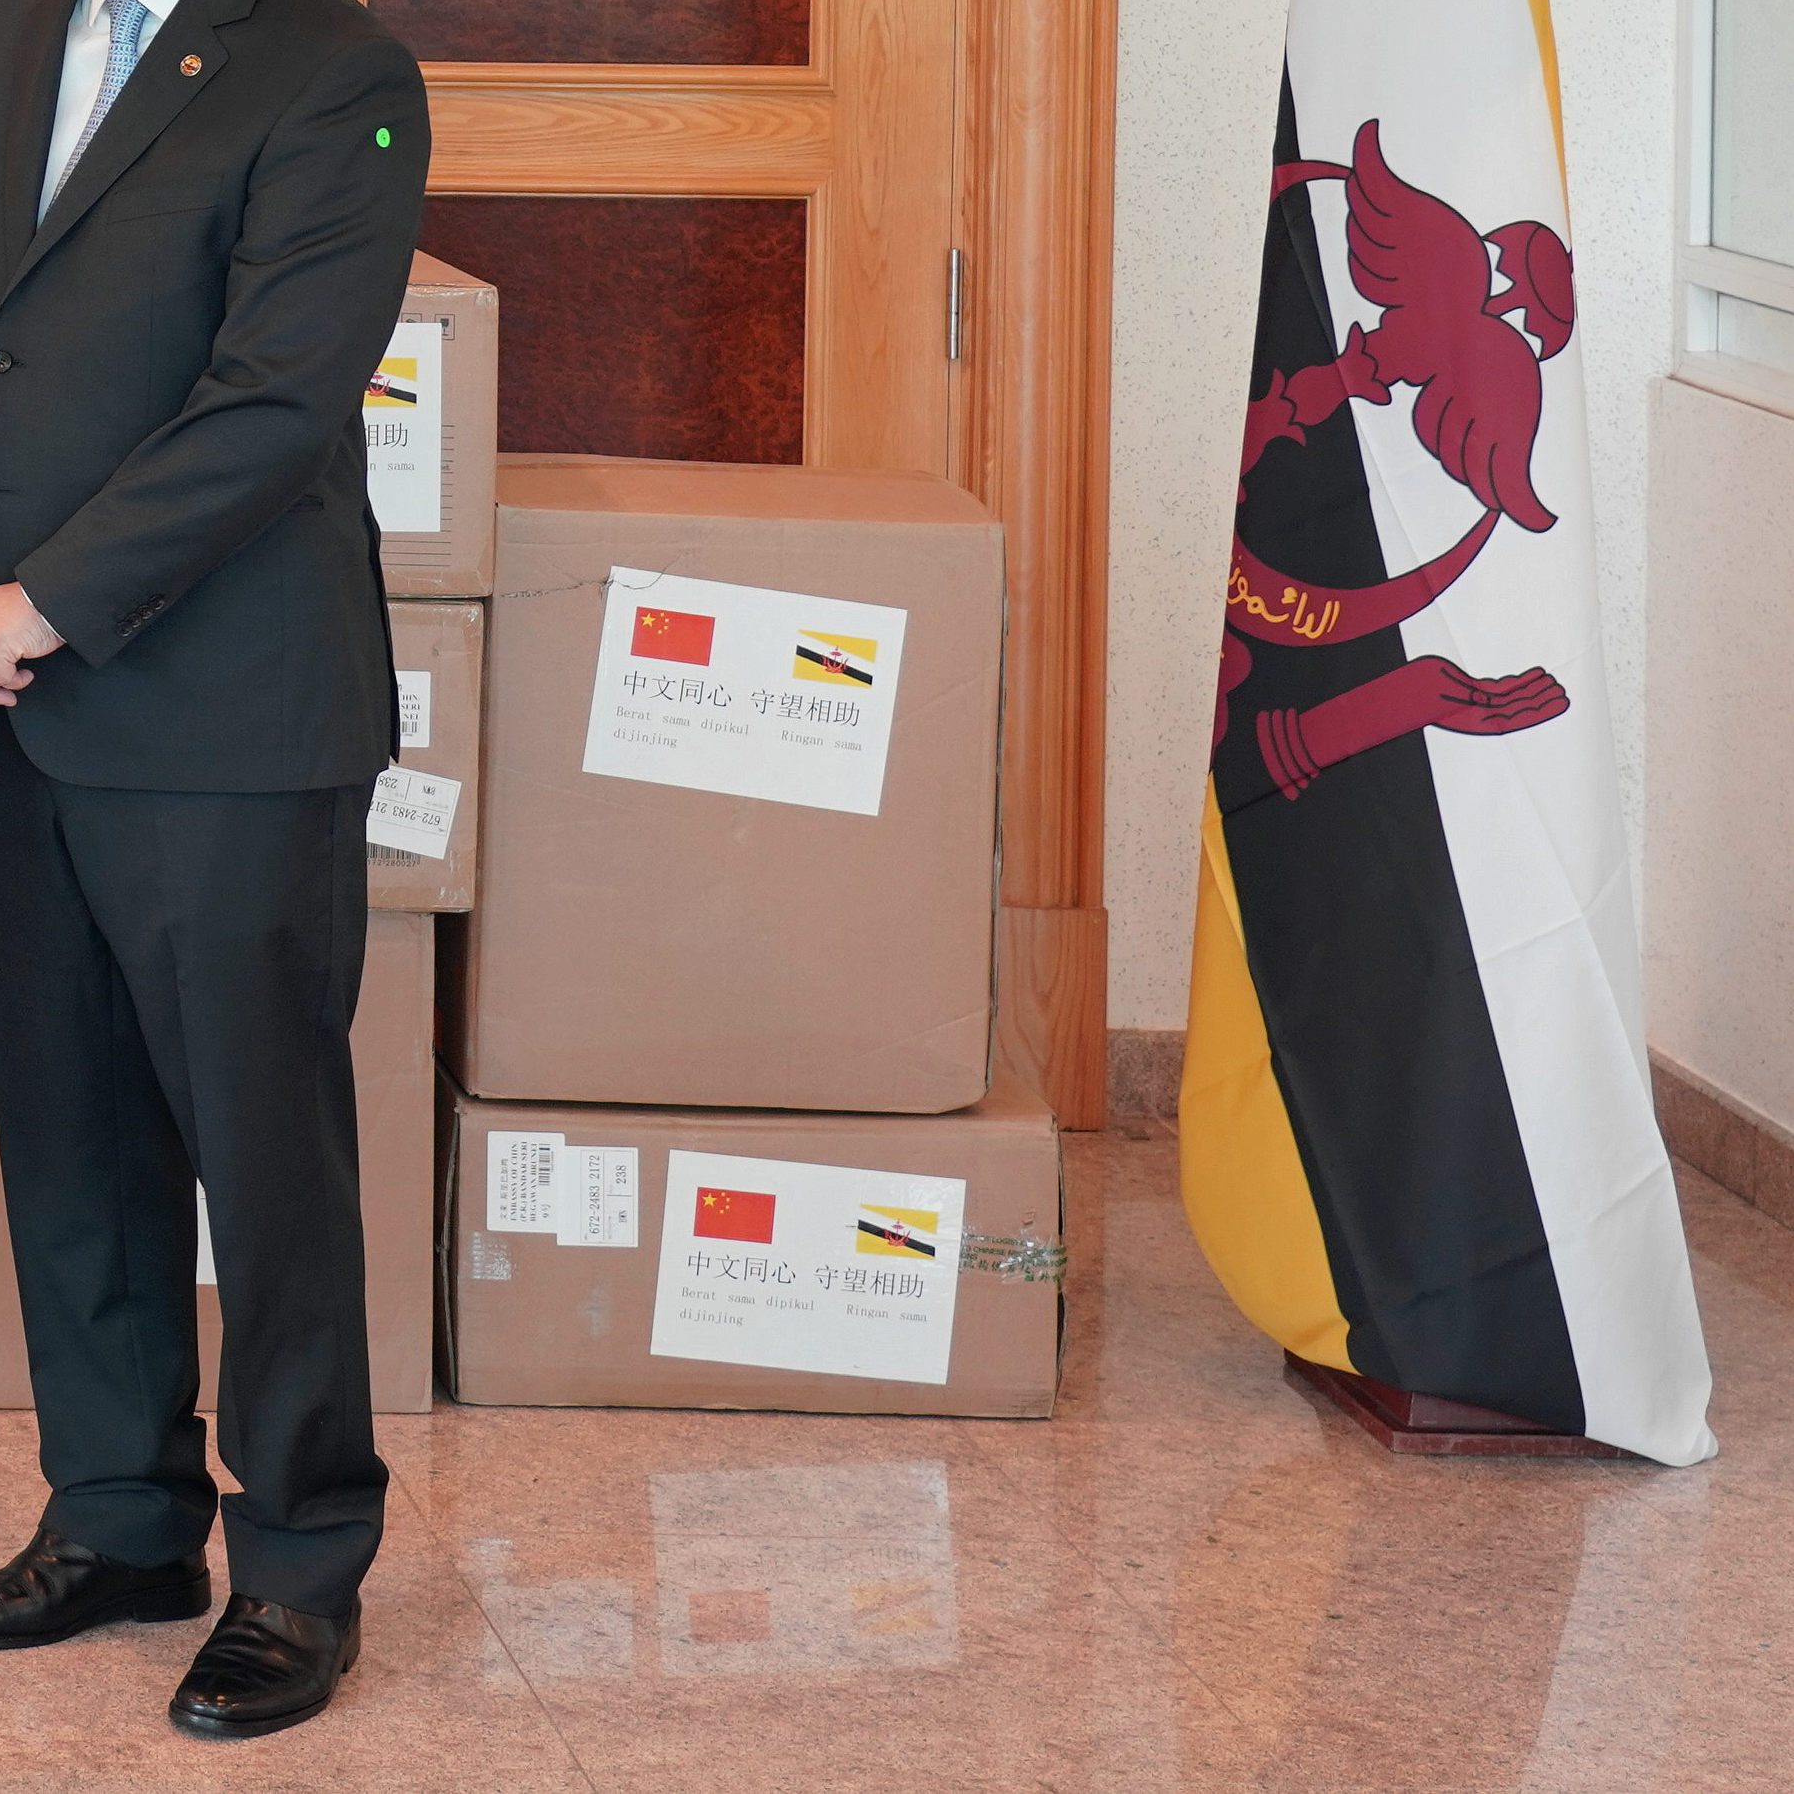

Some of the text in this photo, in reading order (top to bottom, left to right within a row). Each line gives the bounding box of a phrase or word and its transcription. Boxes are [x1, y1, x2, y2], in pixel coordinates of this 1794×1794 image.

[387, 463, 415, 471] sama
[624, 671, 860, 727] 中文同心 守望相助
[612, 726, 679, 750] dijinjing
[615, 705, 863, 752] Berat sama dipikul Ringan sama
[616, 1165, 627, 1184] 238
[589, 1155, 600, 1234] 672-2483 2172
[688, 1251, 796, 1284] 中文同心
[815, 1265, 924, 1299] 守望相助
[678, 1307, 745, 1328] dijinjing
[681, 1285, 928, 1323] Berat sama dipikul Ringan sama
